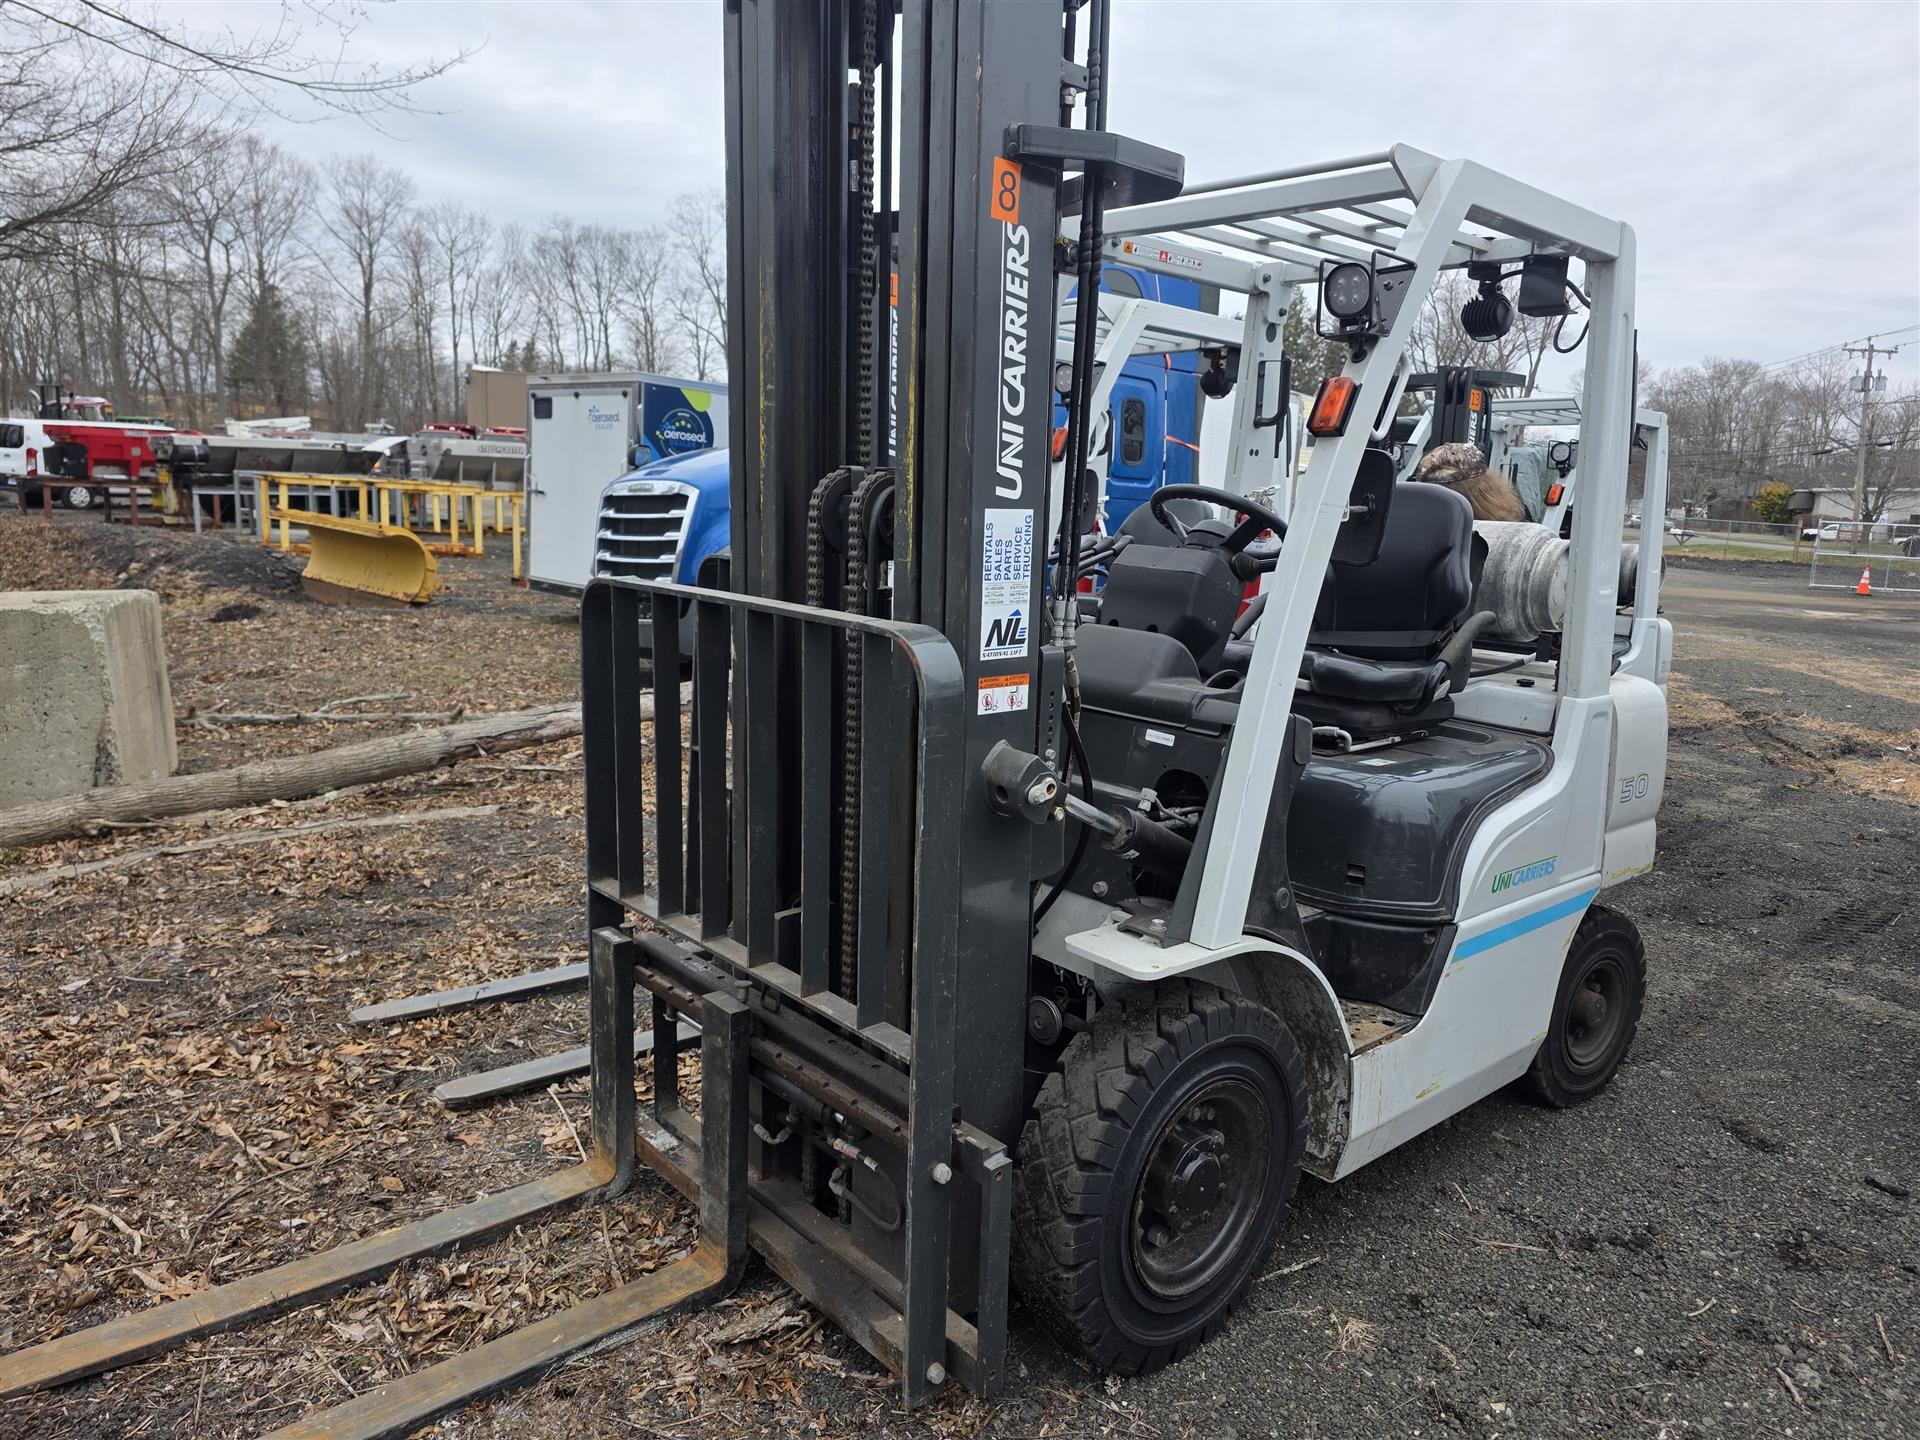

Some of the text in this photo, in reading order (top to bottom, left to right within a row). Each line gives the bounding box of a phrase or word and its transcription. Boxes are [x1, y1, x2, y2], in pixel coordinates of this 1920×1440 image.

[999, 170, 1017, 212] 8
[995, 220, 1030, 500] UNICARRIERS
[663, 429, 706, 443] aeroseal
[984, 522, 994, 581] RENTALS
[994, 539, 1003, 581] SALES
[1004, 540, 1012, 581] PARTS
[1013, 526, 1023, 581] SERVICE
[1022, 514, 1033, 580] TRUCKING
[982, 648, 1022, 658] NATIONAL LIFT
[1620, 772, 1649, 804] 50
[1491, 857, 1558, 894] UNICARRIERS
